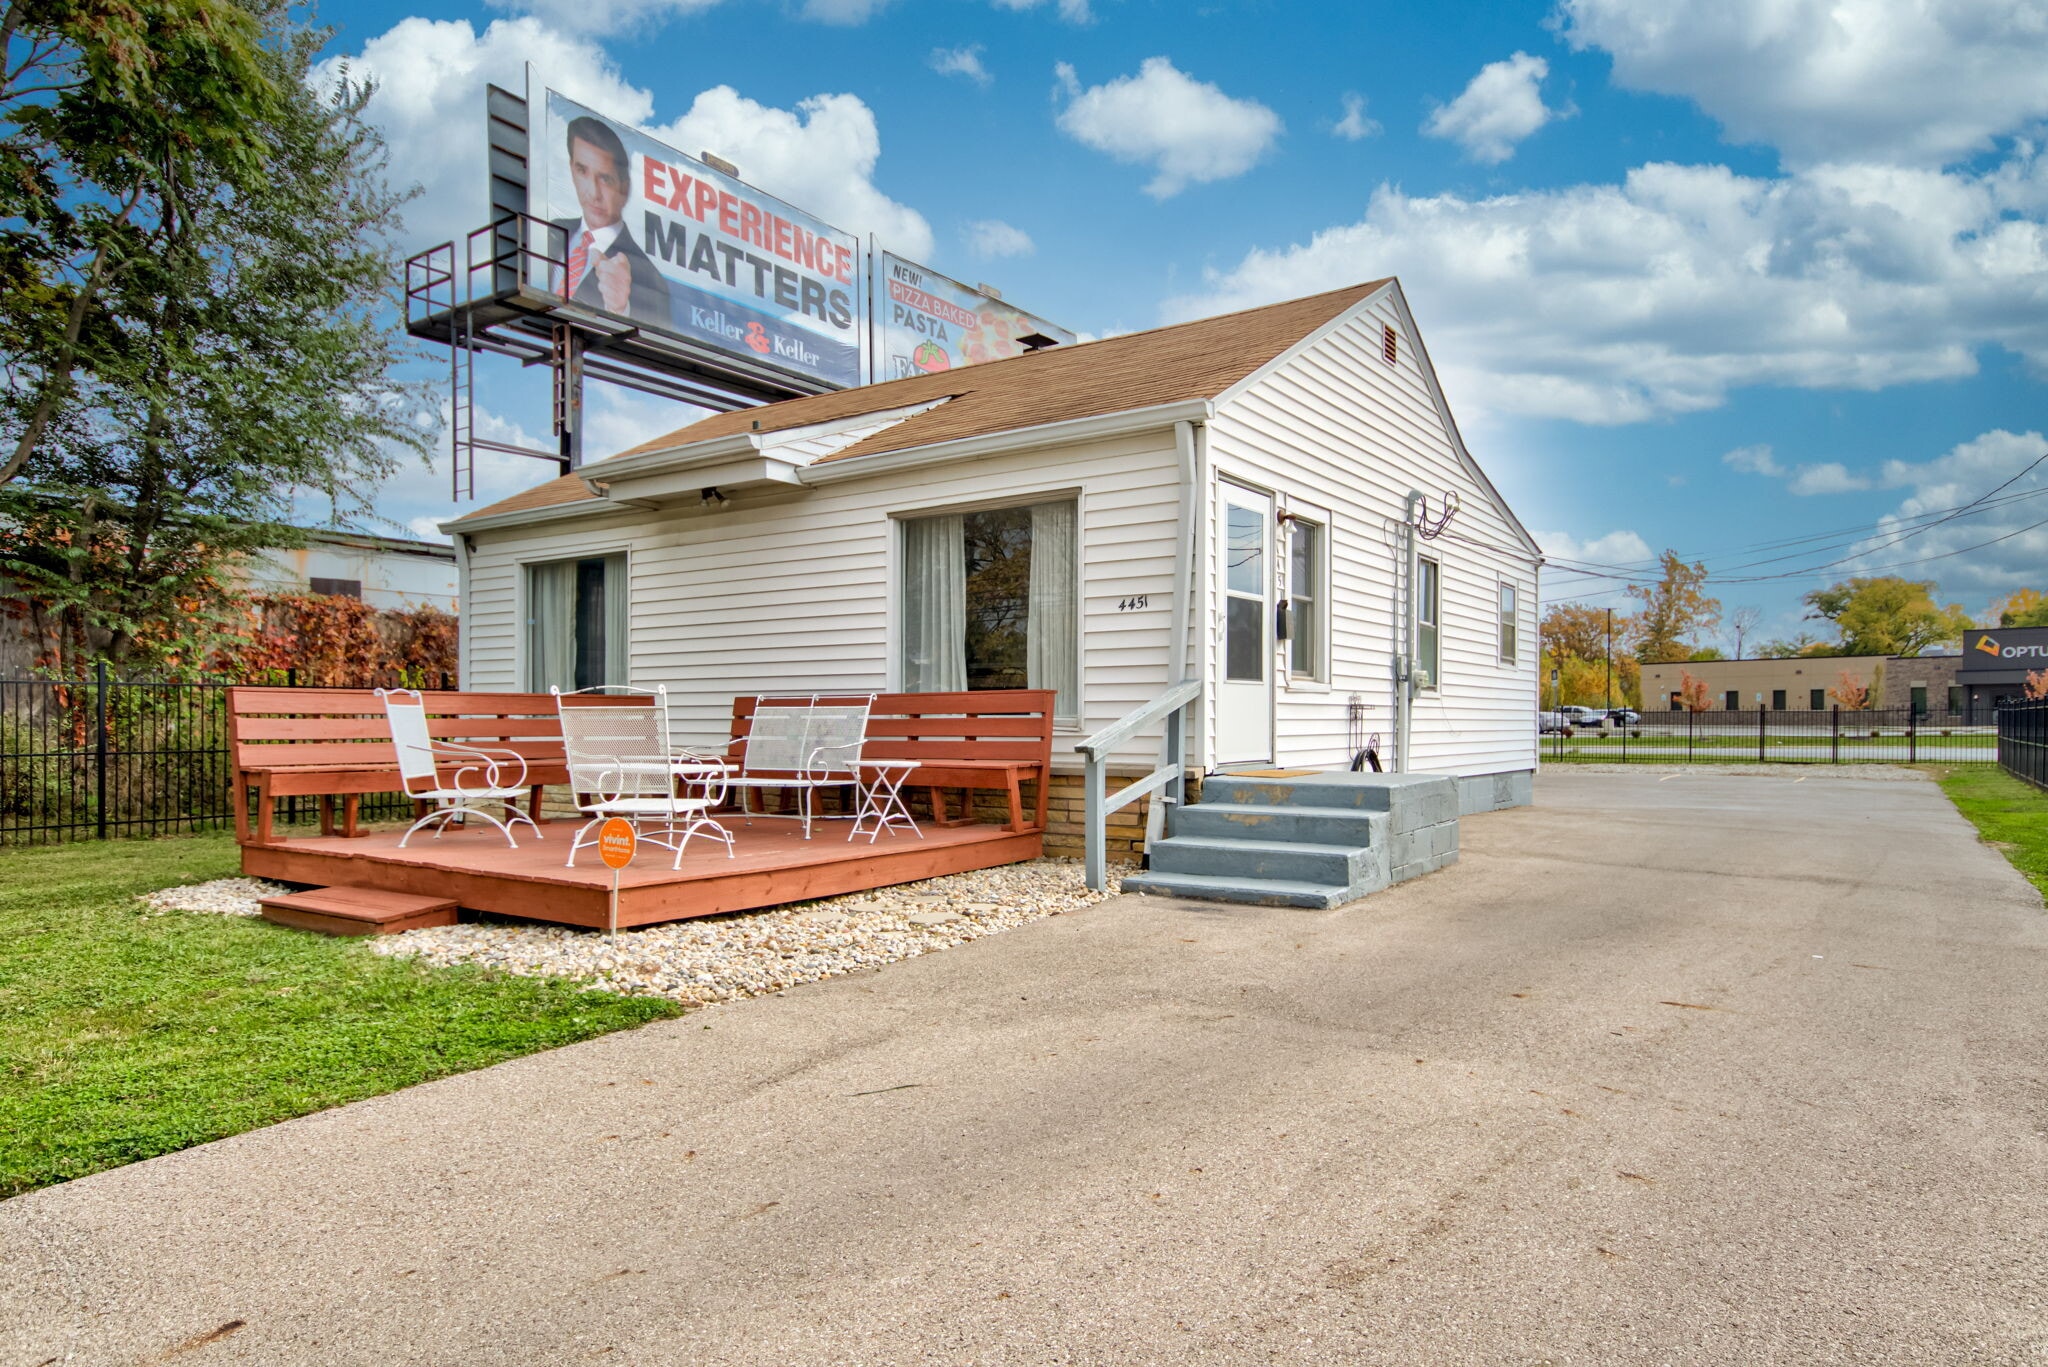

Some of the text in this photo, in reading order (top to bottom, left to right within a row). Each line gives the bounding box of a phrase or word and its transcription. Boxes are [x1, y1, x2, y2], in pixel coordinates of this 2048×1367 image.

[643, 155, 852, 285] EXPERIENCE
[644, 210, 852, 330] MATTERS
[893, 264, 922, 288] NEW!
[893, 283, 975, 328] PIZZA BAKED
[894, 304, 948, 342] PASTA
[690, 306, 820, 367] Keller & Keller
[1118, 594, 1148, 612] 4451
